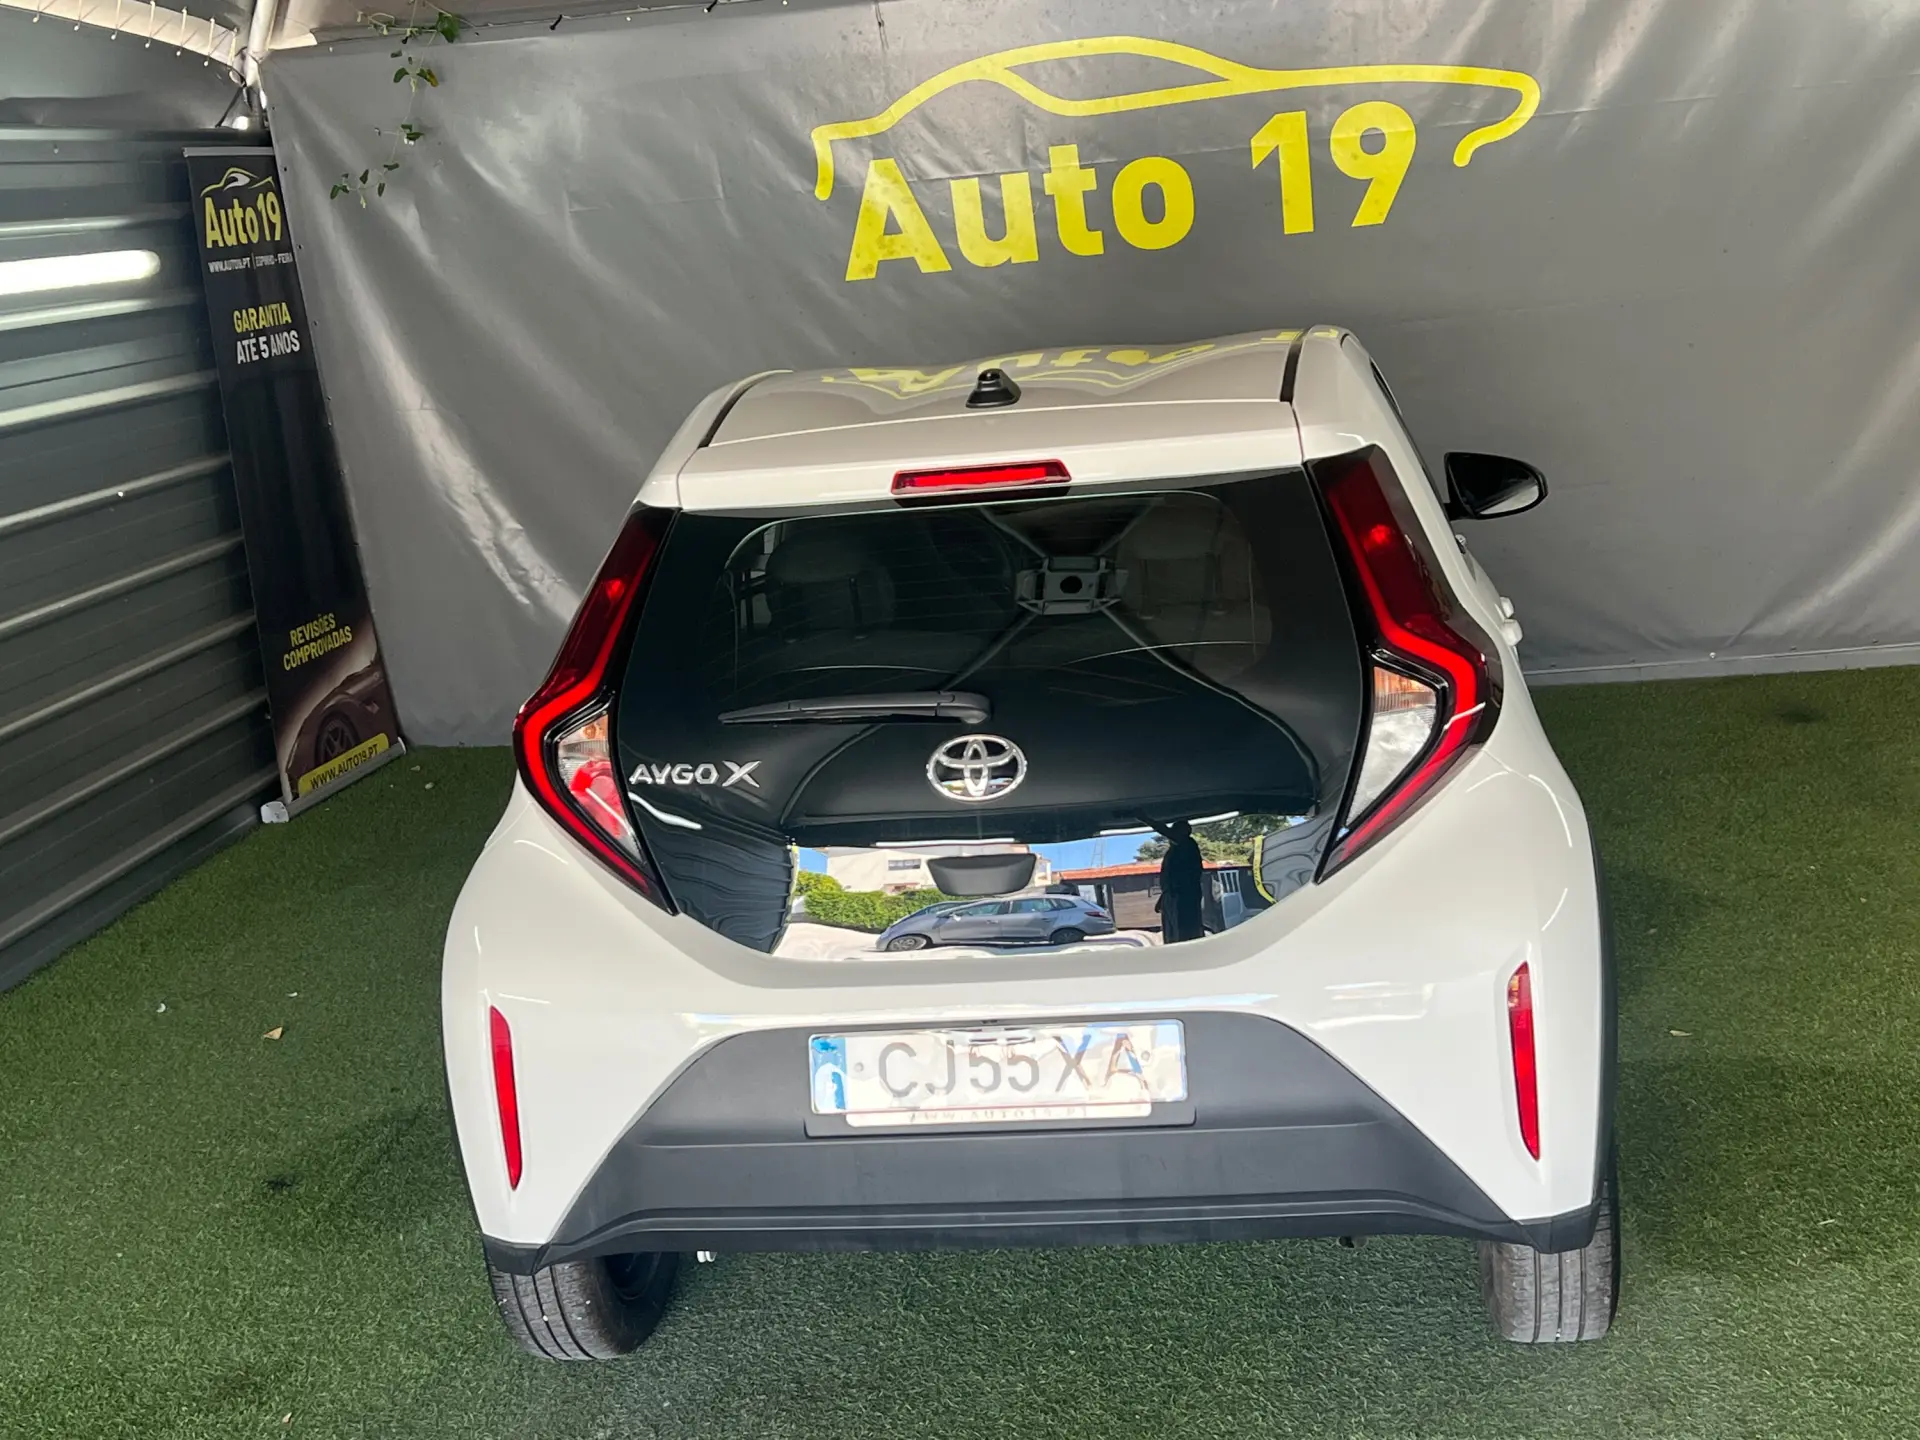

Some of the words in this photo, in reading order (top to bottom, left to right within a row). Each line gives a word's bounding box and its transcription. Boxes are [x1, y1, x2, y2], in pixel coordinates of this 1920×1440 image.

[845, 144, 1195, 281] Auto
[1250, 101, 1416, 235] 19
[233, 302, 292, 333] GARANTIA
[236, 333, 259, 364] ATÉ
[258, 337, 270, 359] 5
[270, 330, 300, 357] ANOS
[289, 613, 336, 647] REVISÕES
[283, 626, 353, 671] COMPROVADAS
[309, 743, 379, 789] WWW.AUTO19.PT
[629, 763, 720, 785] AYGO
[721, 760, 762, 788] X
